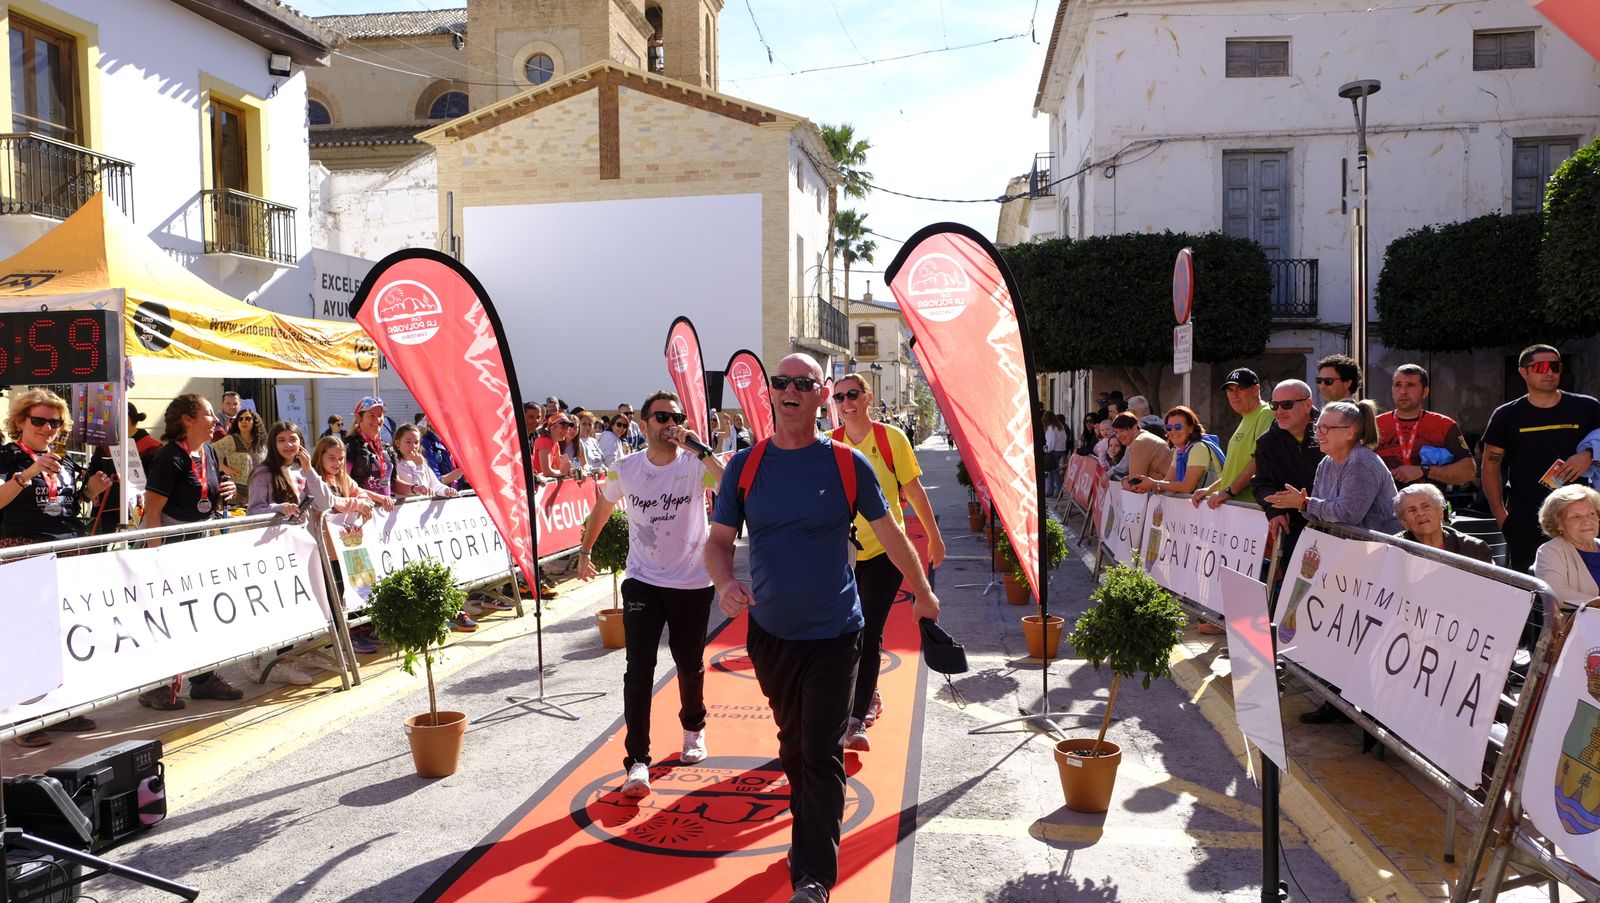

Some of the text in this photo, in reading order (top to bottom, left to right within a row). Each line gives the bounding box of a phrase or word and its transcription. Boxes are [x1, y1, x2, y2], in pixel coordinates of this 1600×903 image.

[322, 273, 362, 294] EXCELE
[0, 317, 103, 376] :59
[541, 497, 592, 534] VEOLIA
[629, 493, 659, 514] Pepe
[650, 513, 676, 525] speaker
[378, 517, 477, 544] AYUNTAMIENTO
[1243, 537, 1257, 555] DE
[381, 530, 503, 576] CANTORIA
[62, 552, 298, 613] AYUNTAMIENTO DE
[65, 574, 313, 662] CANTORIA
[1314, 572, 1495, 661] YUNTMIENTO DE
[1306, 595, 1481, 728] CANTORIA
[649, 772, 788, 787] POLVOR
